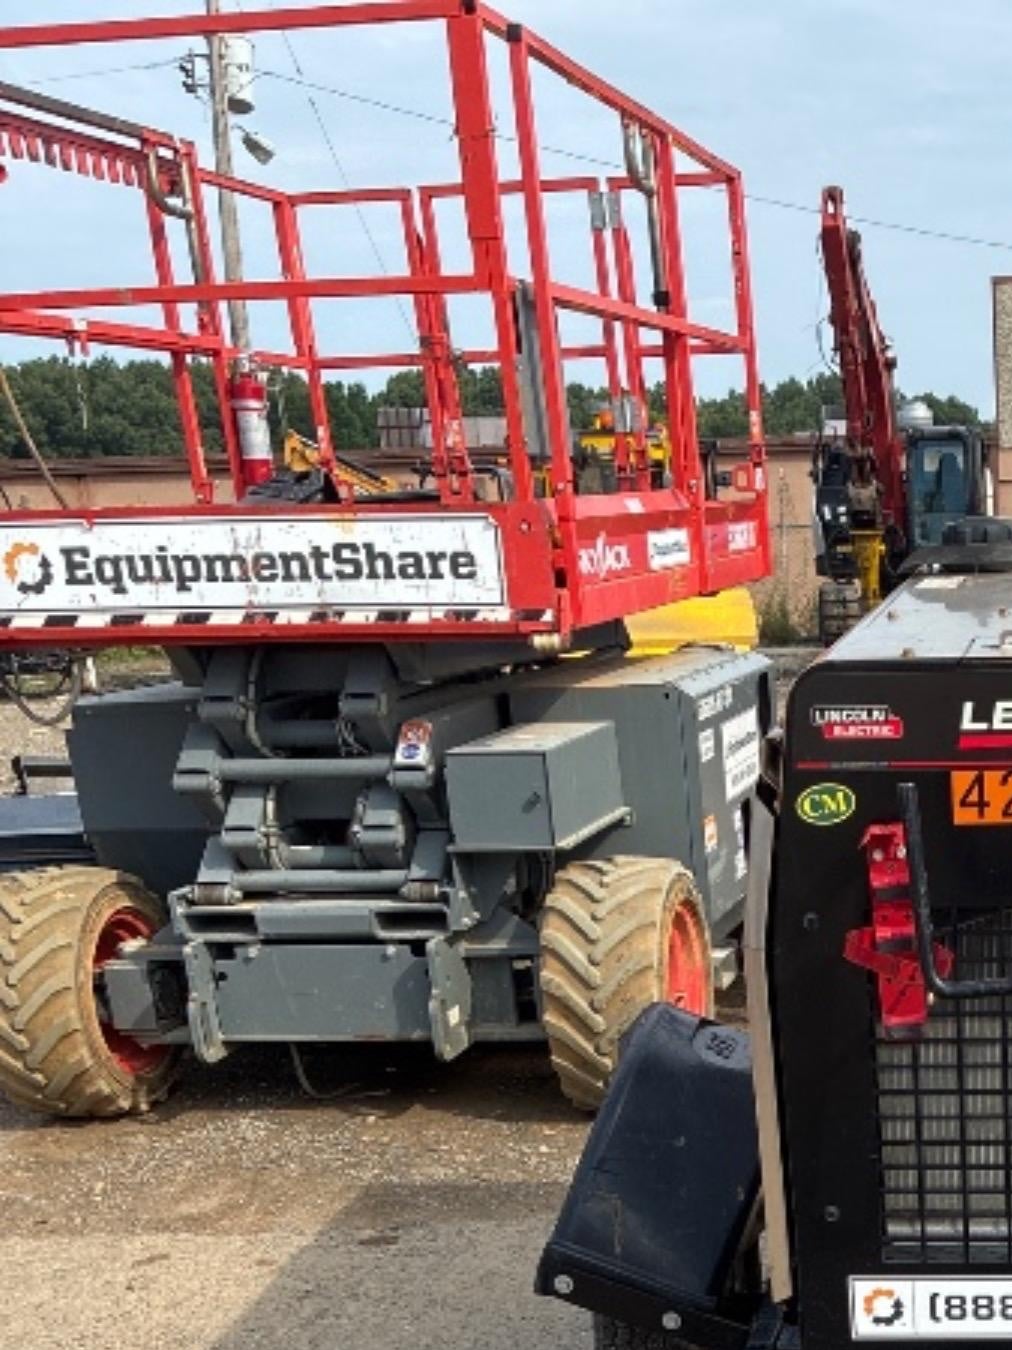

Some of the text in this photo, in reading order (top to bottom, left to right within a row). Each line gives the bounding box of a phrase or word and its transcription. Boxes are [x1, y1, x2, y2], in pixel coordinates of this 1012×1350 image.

[60, 541, 477, 594] EquipmentShare
[814, 709, 886, 723] LINCOLN
[803, 791, 847, 816] CM
